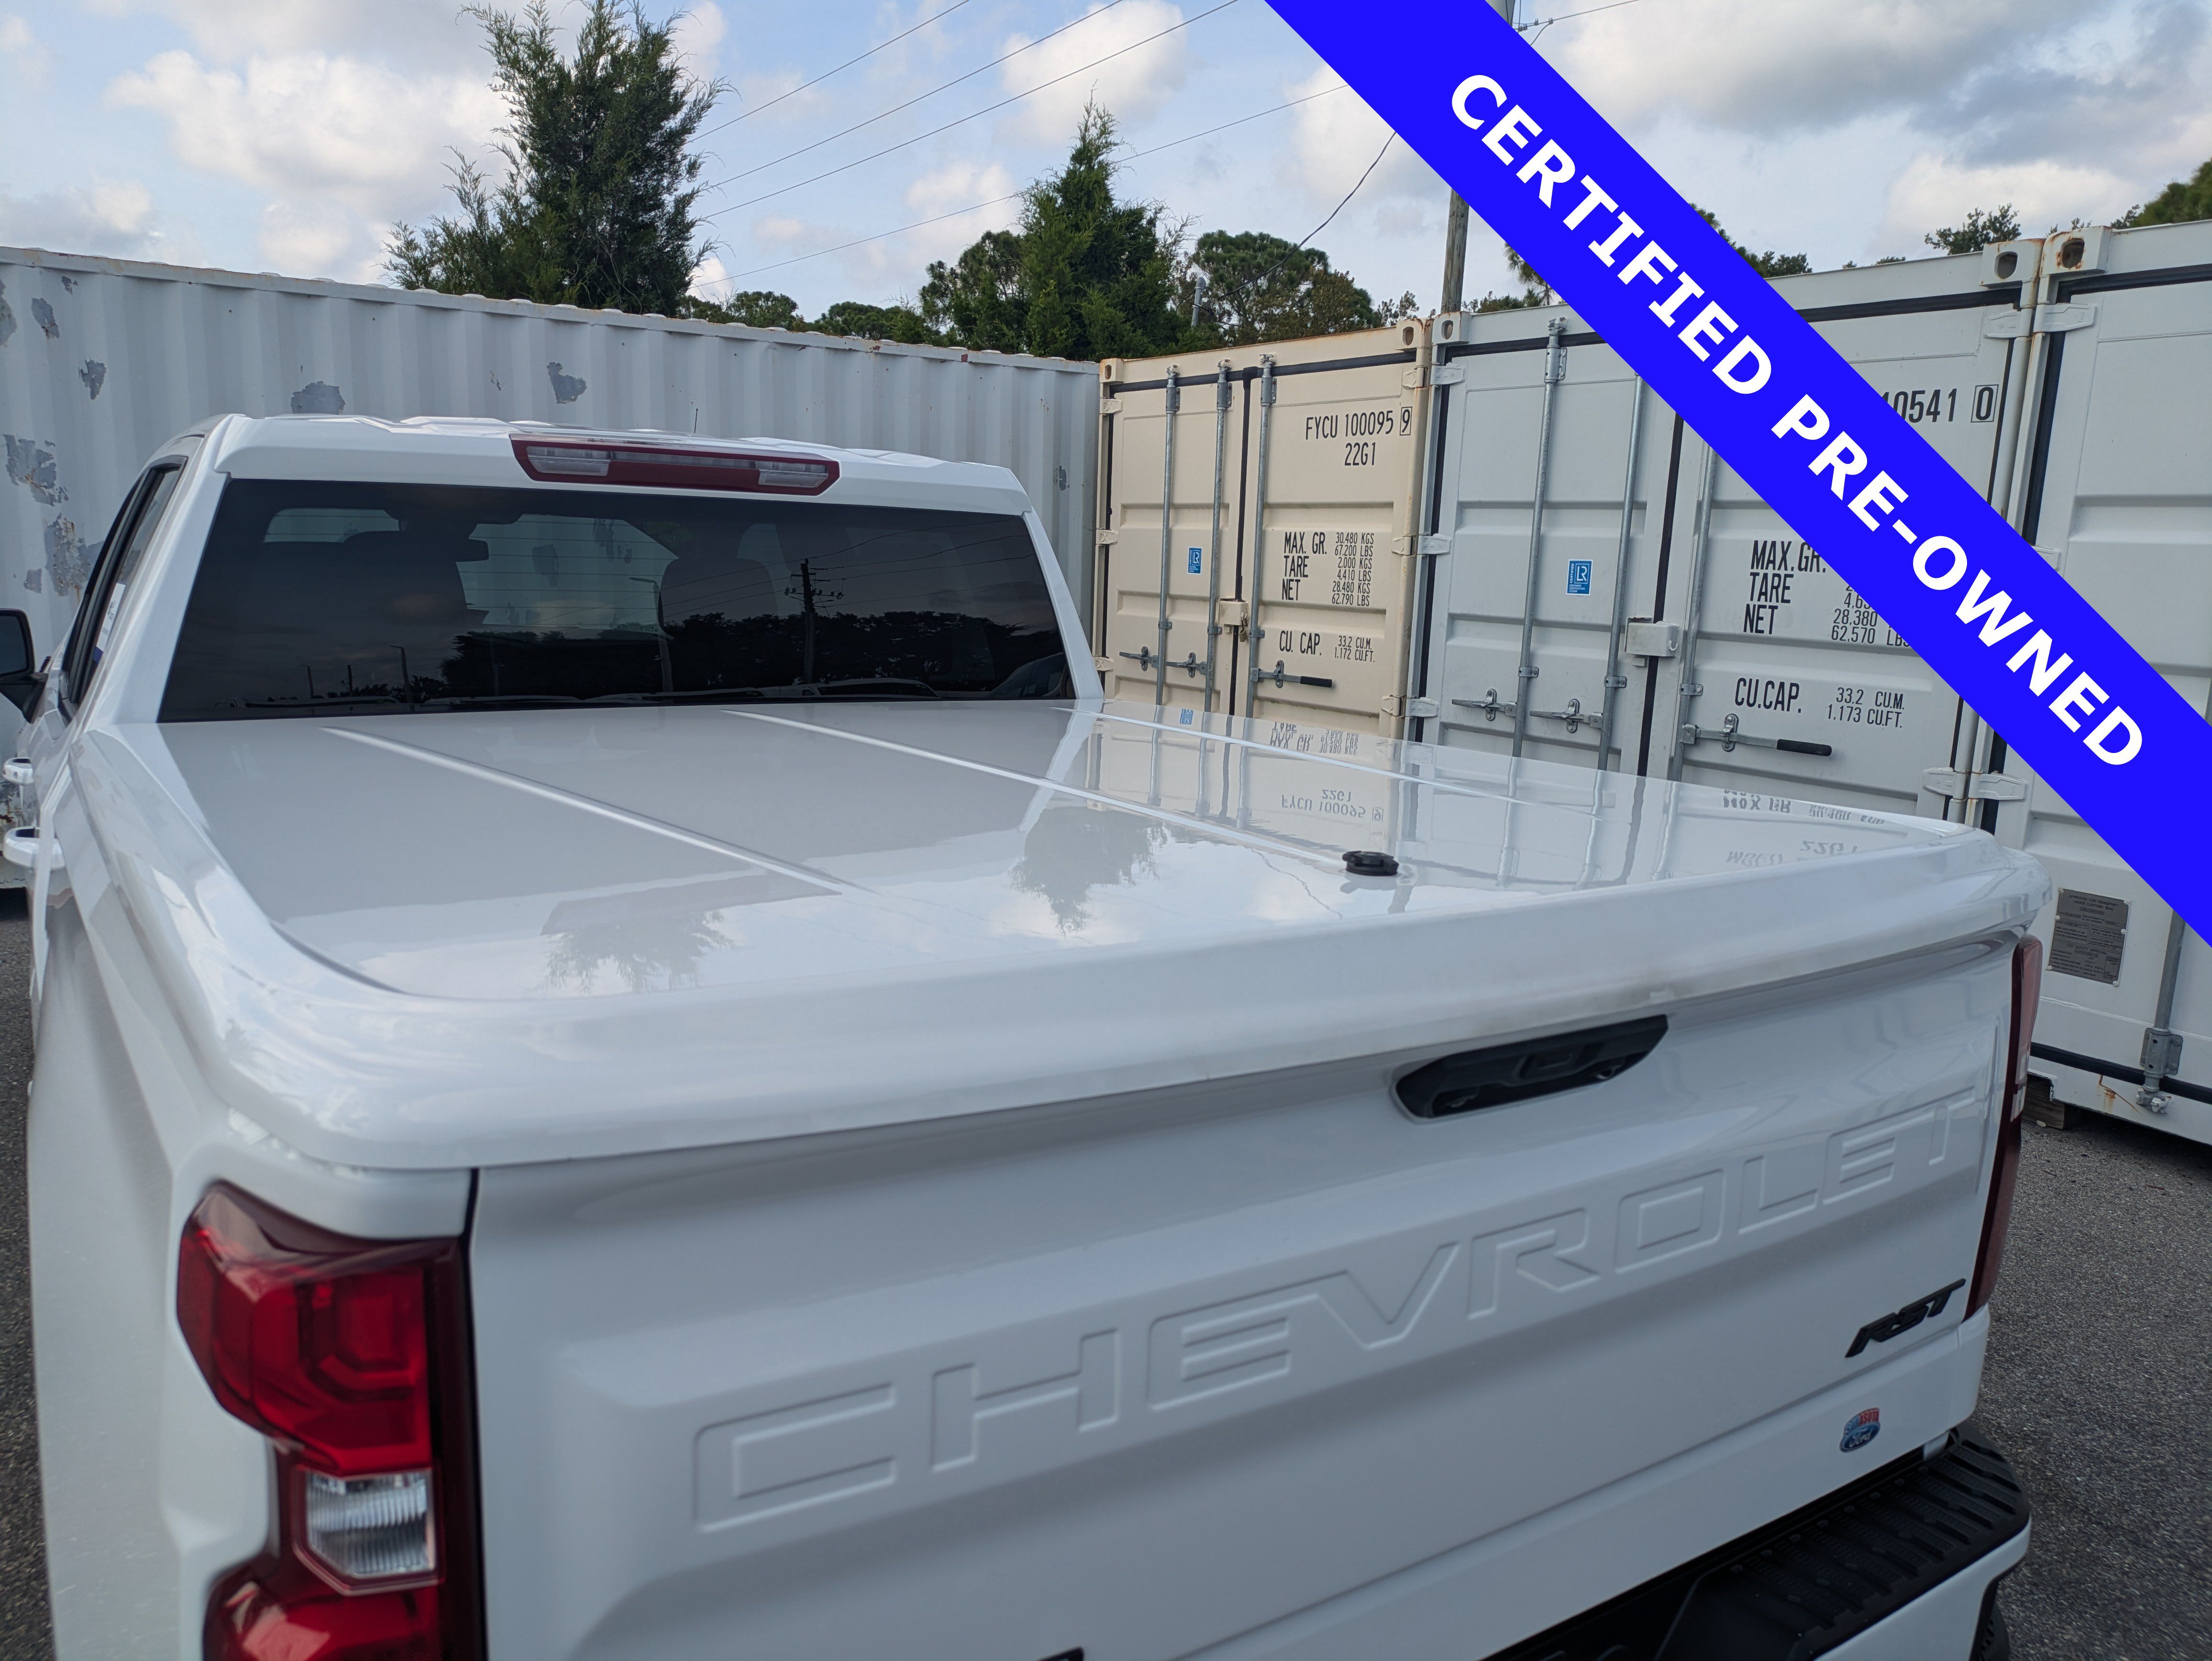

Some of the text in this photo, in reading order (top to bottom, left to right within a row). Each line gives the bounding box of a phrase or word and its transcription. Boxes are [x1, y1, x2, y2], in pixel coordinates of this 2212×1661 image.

[1975, 387, 1994, 421] 0
[1305, 409, 1411, 440] FYCU 100095 9
[1344, 442, 1376, 466] 22G1
[1284, 532, 1306, 554] MAX.
[1312, 532, 1327, 554] GR.
[1361, 532, 1374, 544] KGS
[1360, 545, 1373, 557] LBS
[1283, 555, 1309, 578] TARE
[1359, 557, 1372, 569] KGS
[1358, 570, 1371, 582] LBS
[1282, 578, 1301, 601] NET
[1358, 582, 1371, 594] KGS
[1750, 572, 1794, 603] TARE
[1357, 594, 1370, 607] LBS
[1743, 603, 1878, 634] NET 28,380
[1279, 630, 1372, 656] CU. CAP. 33.2 CU.M.
[1831, 625, 1910, 647] 62,570 LB
[1355, 649, 1375, 663] CU.FT.
[1836, 687, 1864, 705] 33.2
[1875, 691, 1905, 710] CU.M.
[1867, 709, 1902, 728] CU.FT.
[692, 1085, 1975, 1532] CHEVROLET
[1845, 1278, 1967, 1358] RST
